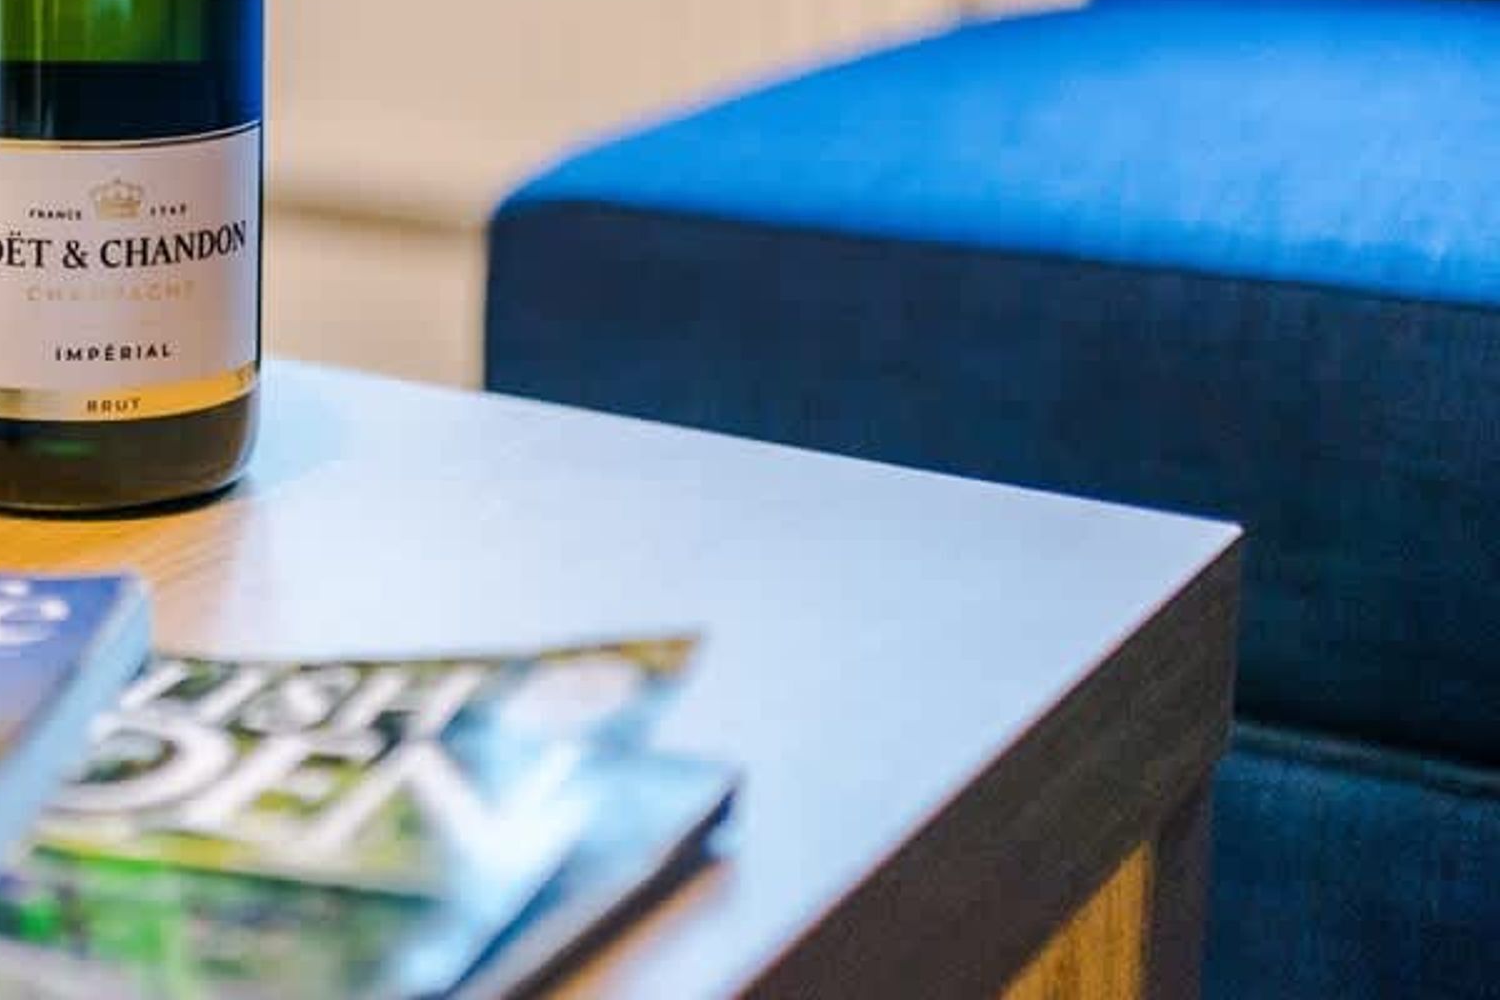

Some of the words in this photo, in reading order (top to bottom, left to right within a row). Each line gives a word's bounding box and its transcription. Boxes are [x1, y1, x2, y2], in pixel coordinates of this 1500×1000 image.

[28, 207, 82, 220] FRANCE
[61, 239, 88, 269] &
[100, 219, 246, 269] CHANDON
[26, 279, 196, 301] CHAAGNE
[55, 343, 172, 361] IMPÉRIAL
[86, 397, 142, 413] BRUT
